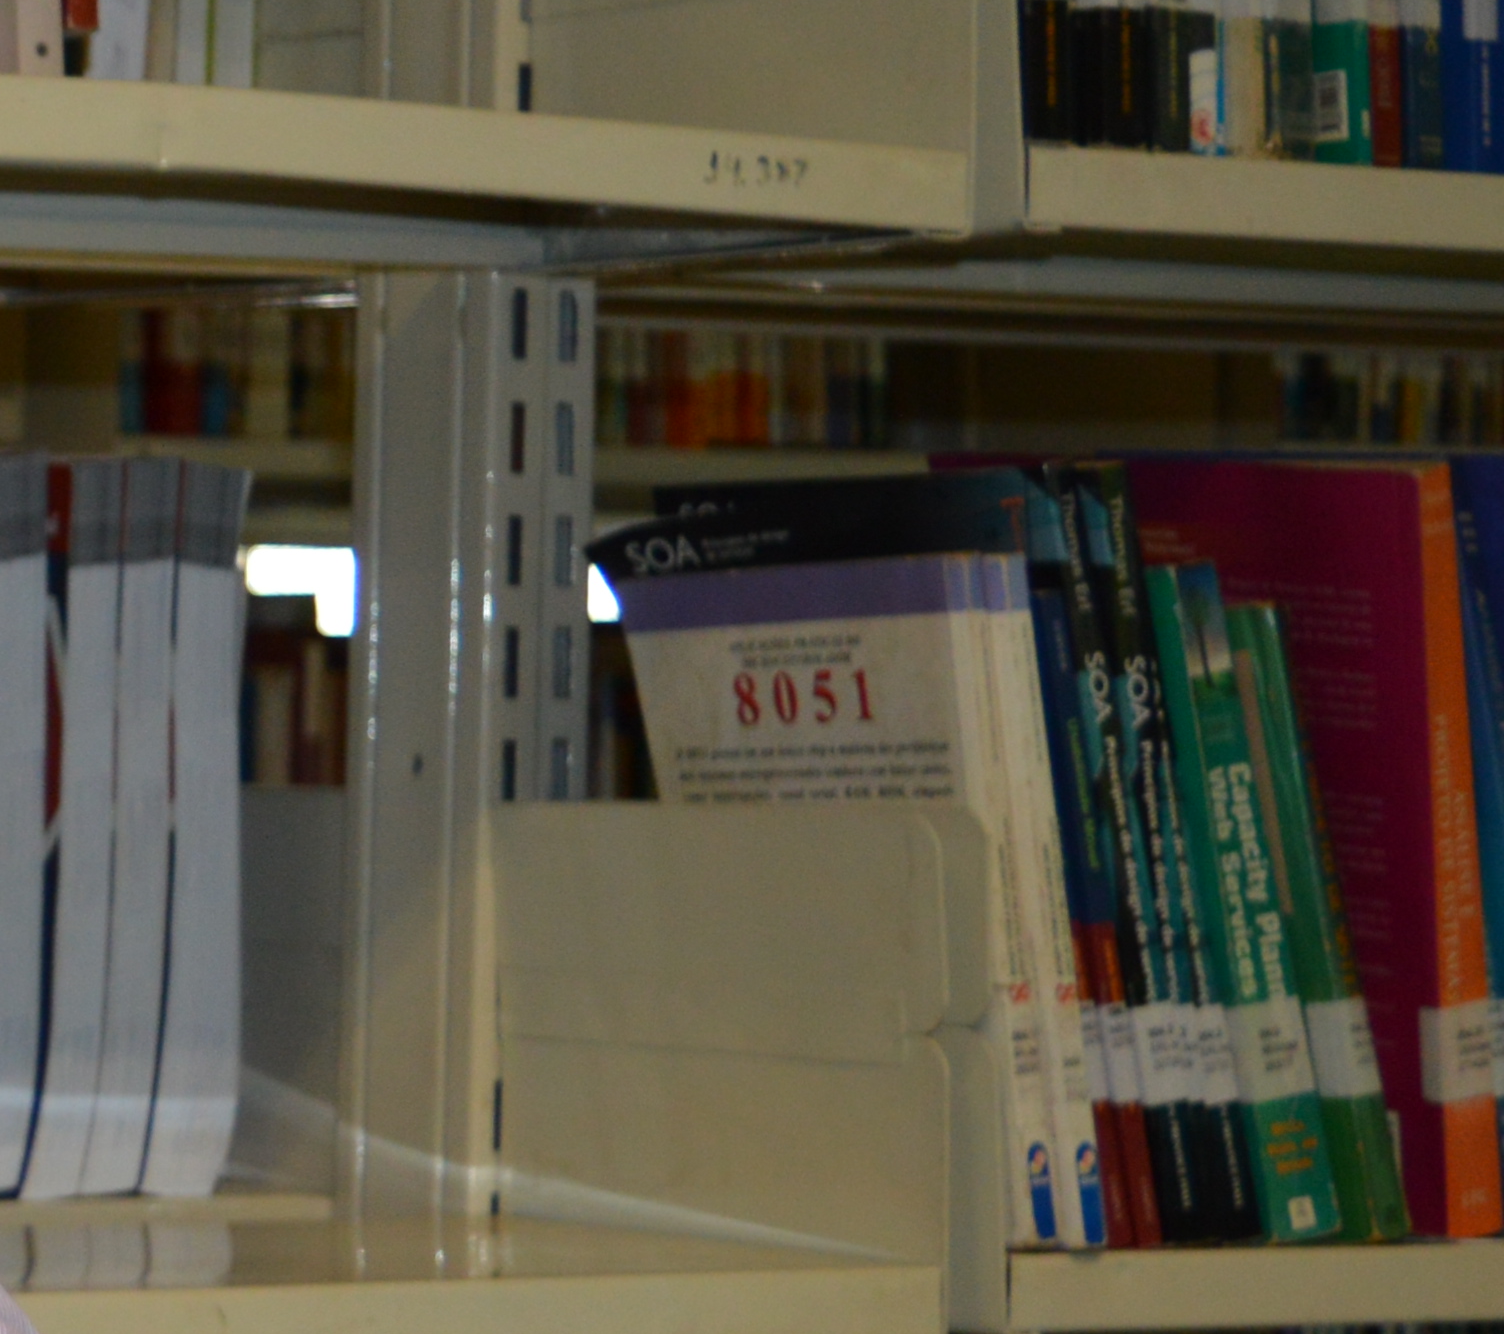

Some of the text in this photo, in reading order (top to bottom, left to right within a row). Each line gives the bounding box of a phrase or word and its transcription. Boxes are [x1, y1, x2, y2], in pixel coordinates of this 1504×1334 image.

[625, 534, 700, 571] SOA
[733, 667, 875, 727] 8051
[1084, 650, 1114, 730] SOA
[1124, 654, 1152, 731] SOA
[1228, 762, 1271, 903] Capacity
[1208, 766, 1258, 999] Web Services
